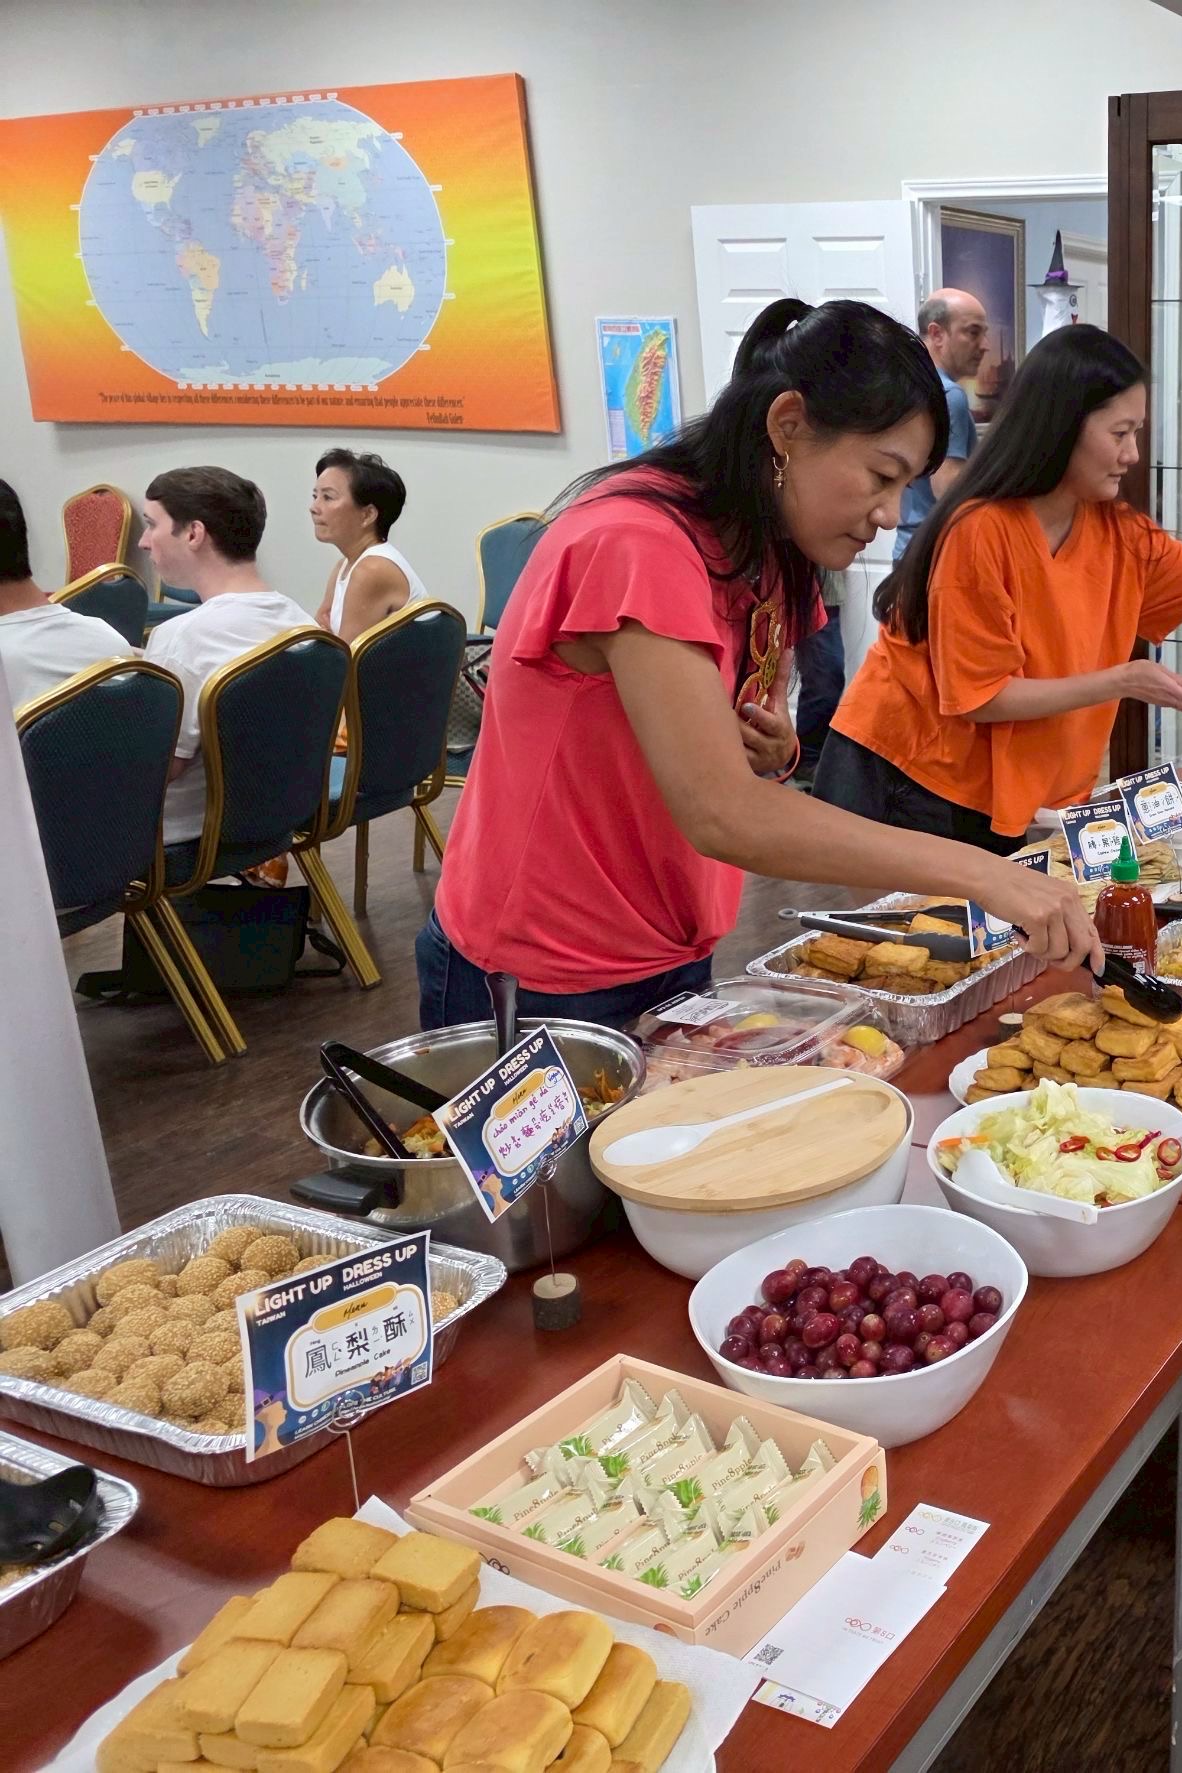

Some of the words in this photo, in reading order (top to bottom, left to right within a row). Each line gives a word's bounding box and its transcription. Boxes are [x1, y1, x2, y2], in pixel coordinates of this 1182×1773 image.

[1082, 809, 1091, 817] UP
[1093, 805, 1112, 815] DRESS
[1112, 804, 1121, 812] UP
[1033, 855, 1045, 864] UP
[498, 1049, 531, 1080] DRESS
[530, 1037, 545, 1054] UP
[504, 1063, 529, 1086] HALLOWEEN
[448, 1088, 483, 1122] LIGHT
[480, 1078, 496, 1096] UP
[453, 1111, 475, 1129] TAIWAN
[342, 1252, 393, 1283] DRESS
[395, 1244, 418, 1263] UP
[343, 1272, 383, 1291] HALLOWEEN
[254, 1283, 306, 1317] LIGHT
[310, 1274, 333, 1294] UP
[256, 1311, 287, 1326] TAIWAN
[704, 1609, 730, 1637] Cake
